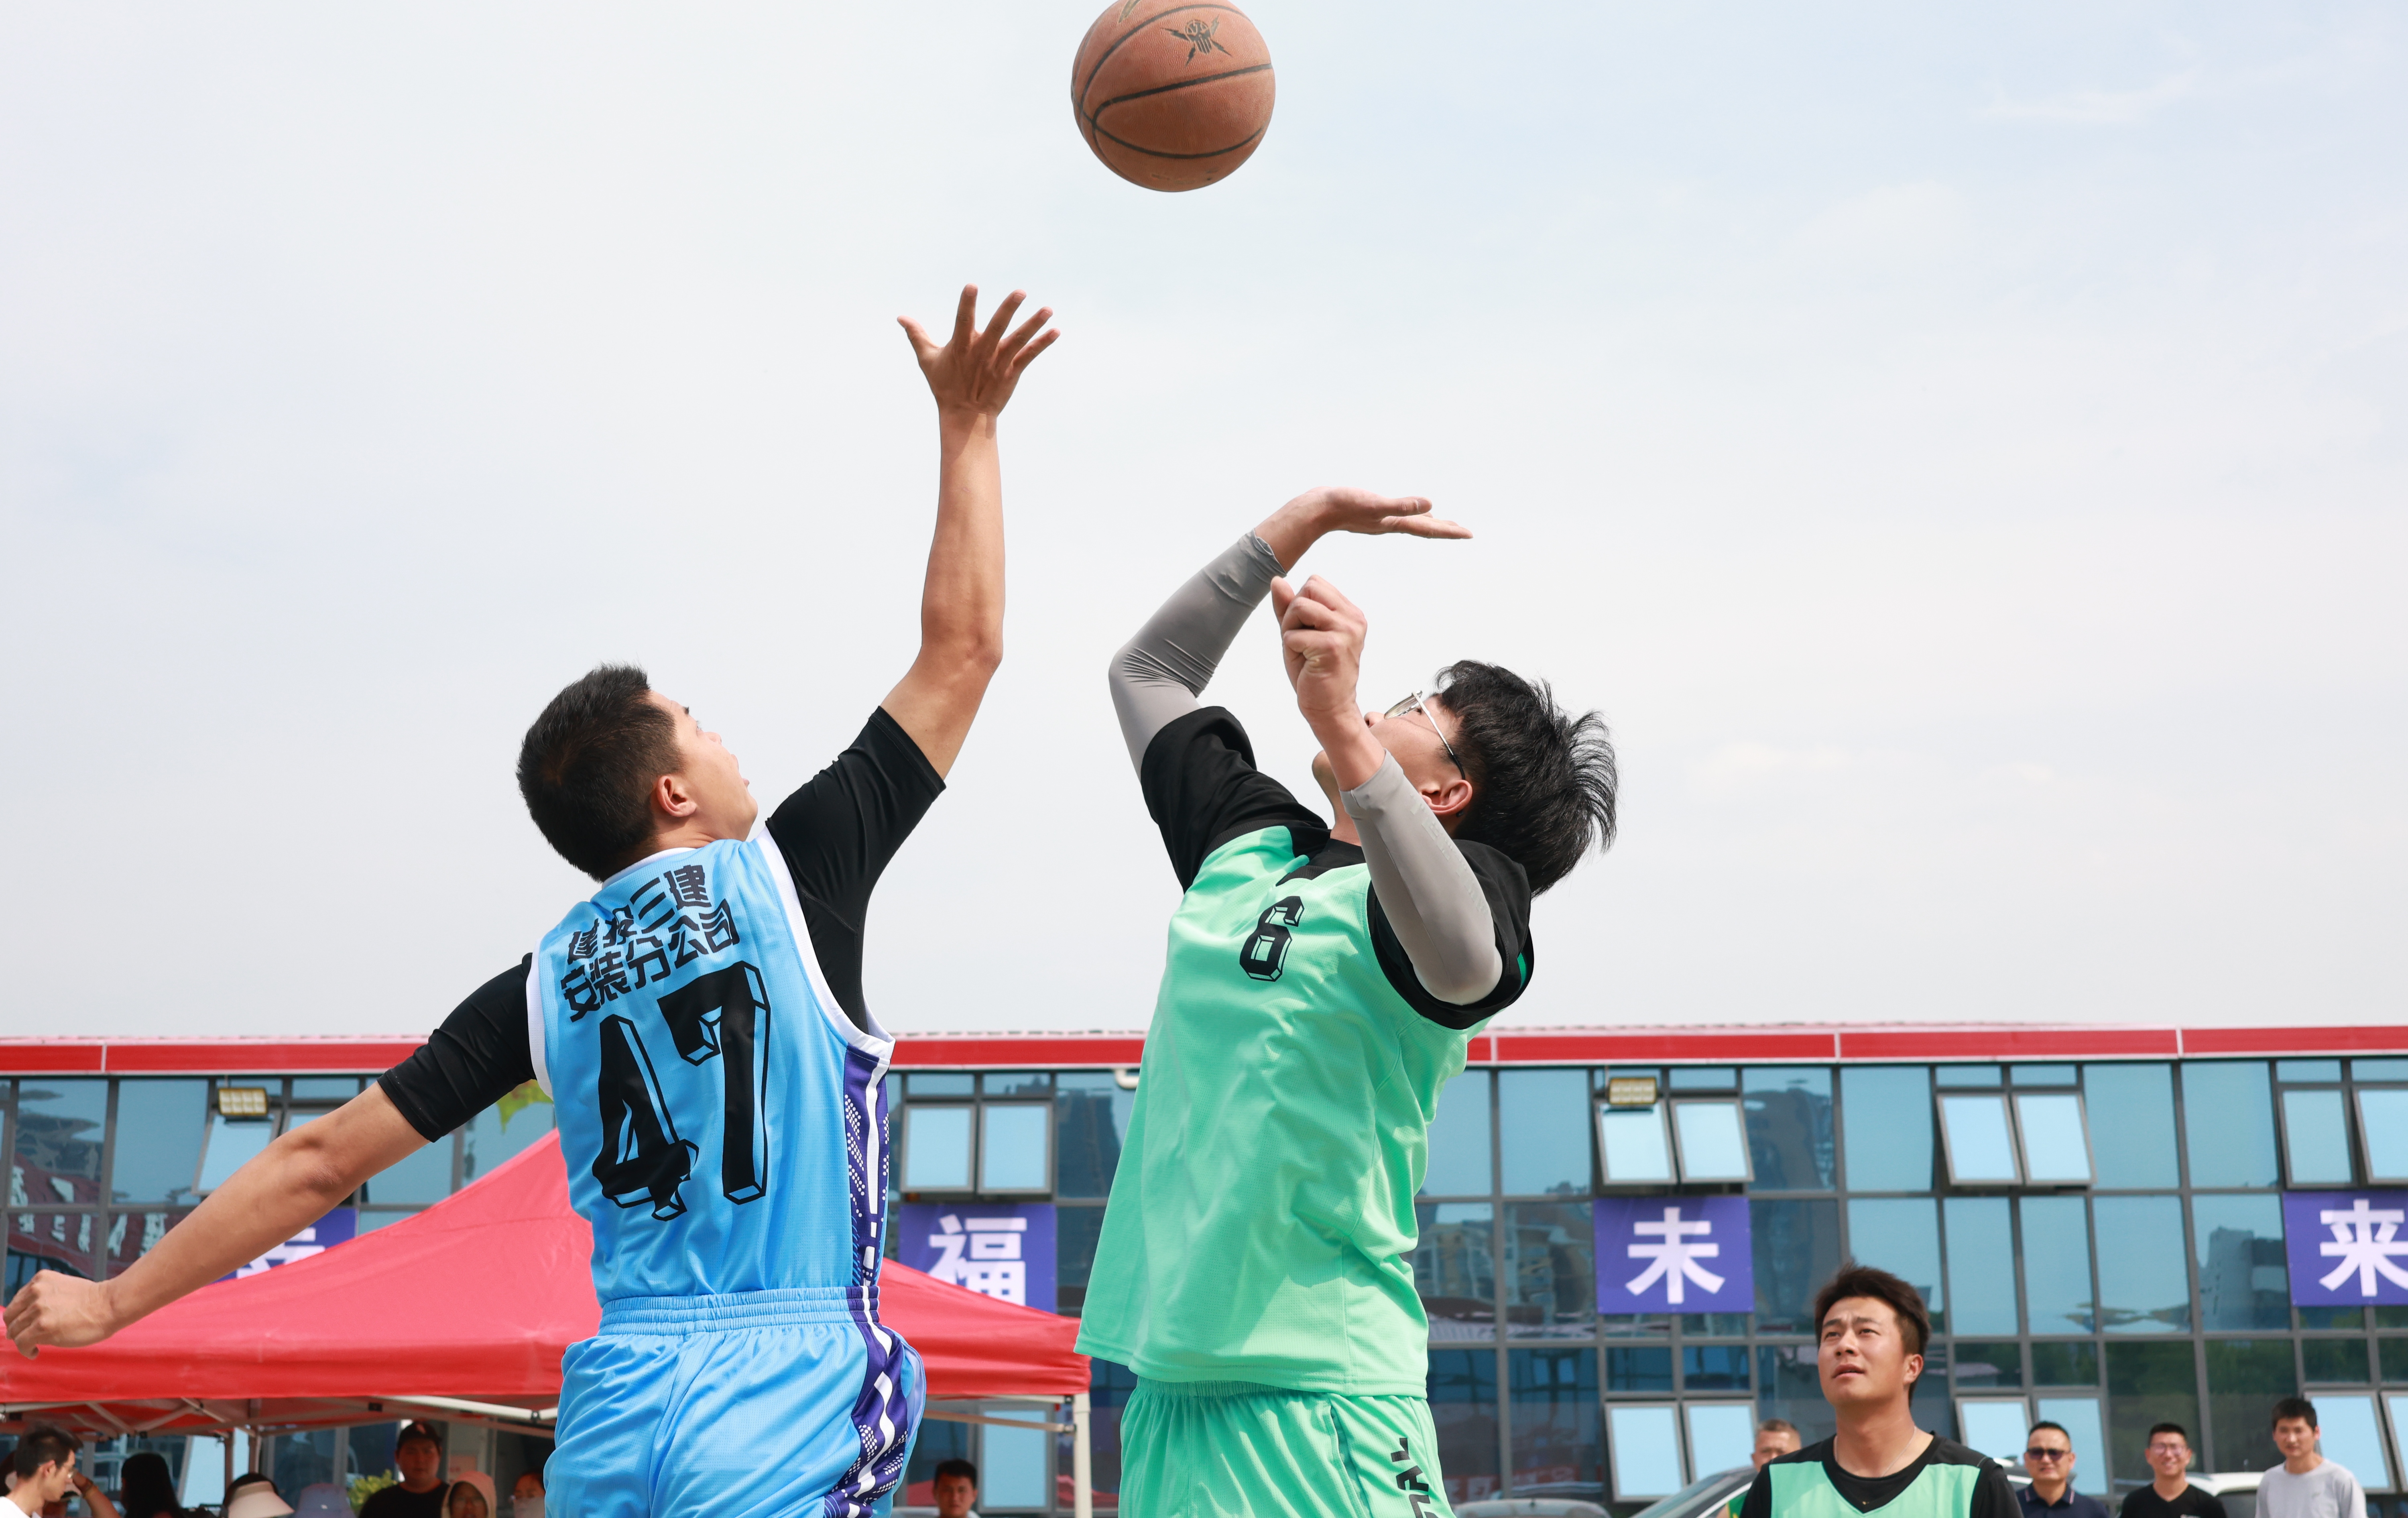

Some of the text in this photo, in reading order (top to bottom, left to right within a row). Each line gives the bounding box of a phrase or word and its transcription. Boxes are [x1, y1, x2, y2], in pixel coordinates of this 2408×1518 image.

[560, 898, 740, 1022] 安装分公司
[567, 864, 712, 965] 建投三建
[1239, 895, 1305, 982] 6
[592, 960, 771, 1222] 47
[928, 1214, 1027, 1305] 福
[1625, 1207, 1725, 1304] 未
[2319, 1199, 2408, 1297] 来
